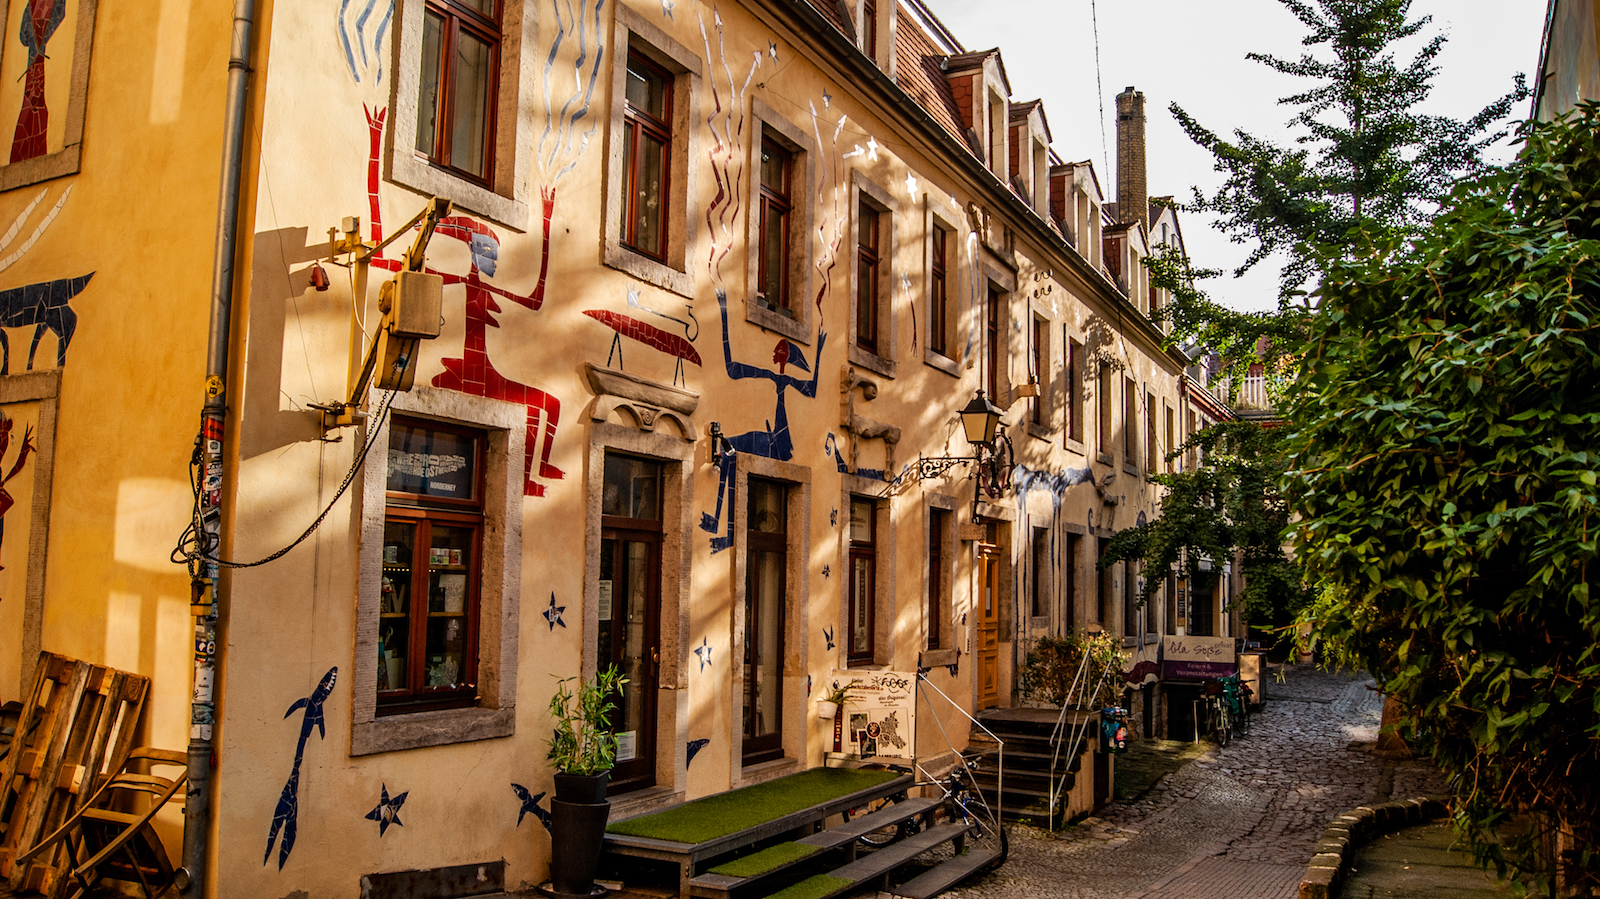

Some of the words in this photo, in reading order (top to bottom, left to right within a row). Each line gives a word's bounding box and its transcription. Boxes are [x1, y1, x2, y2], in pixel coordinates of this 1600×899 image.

[429, 482, 457, 492] NORDERNEY
[1214, 641, 1233, 649] privat
[1175, 669, 1224, 679] Veranstaltungen
